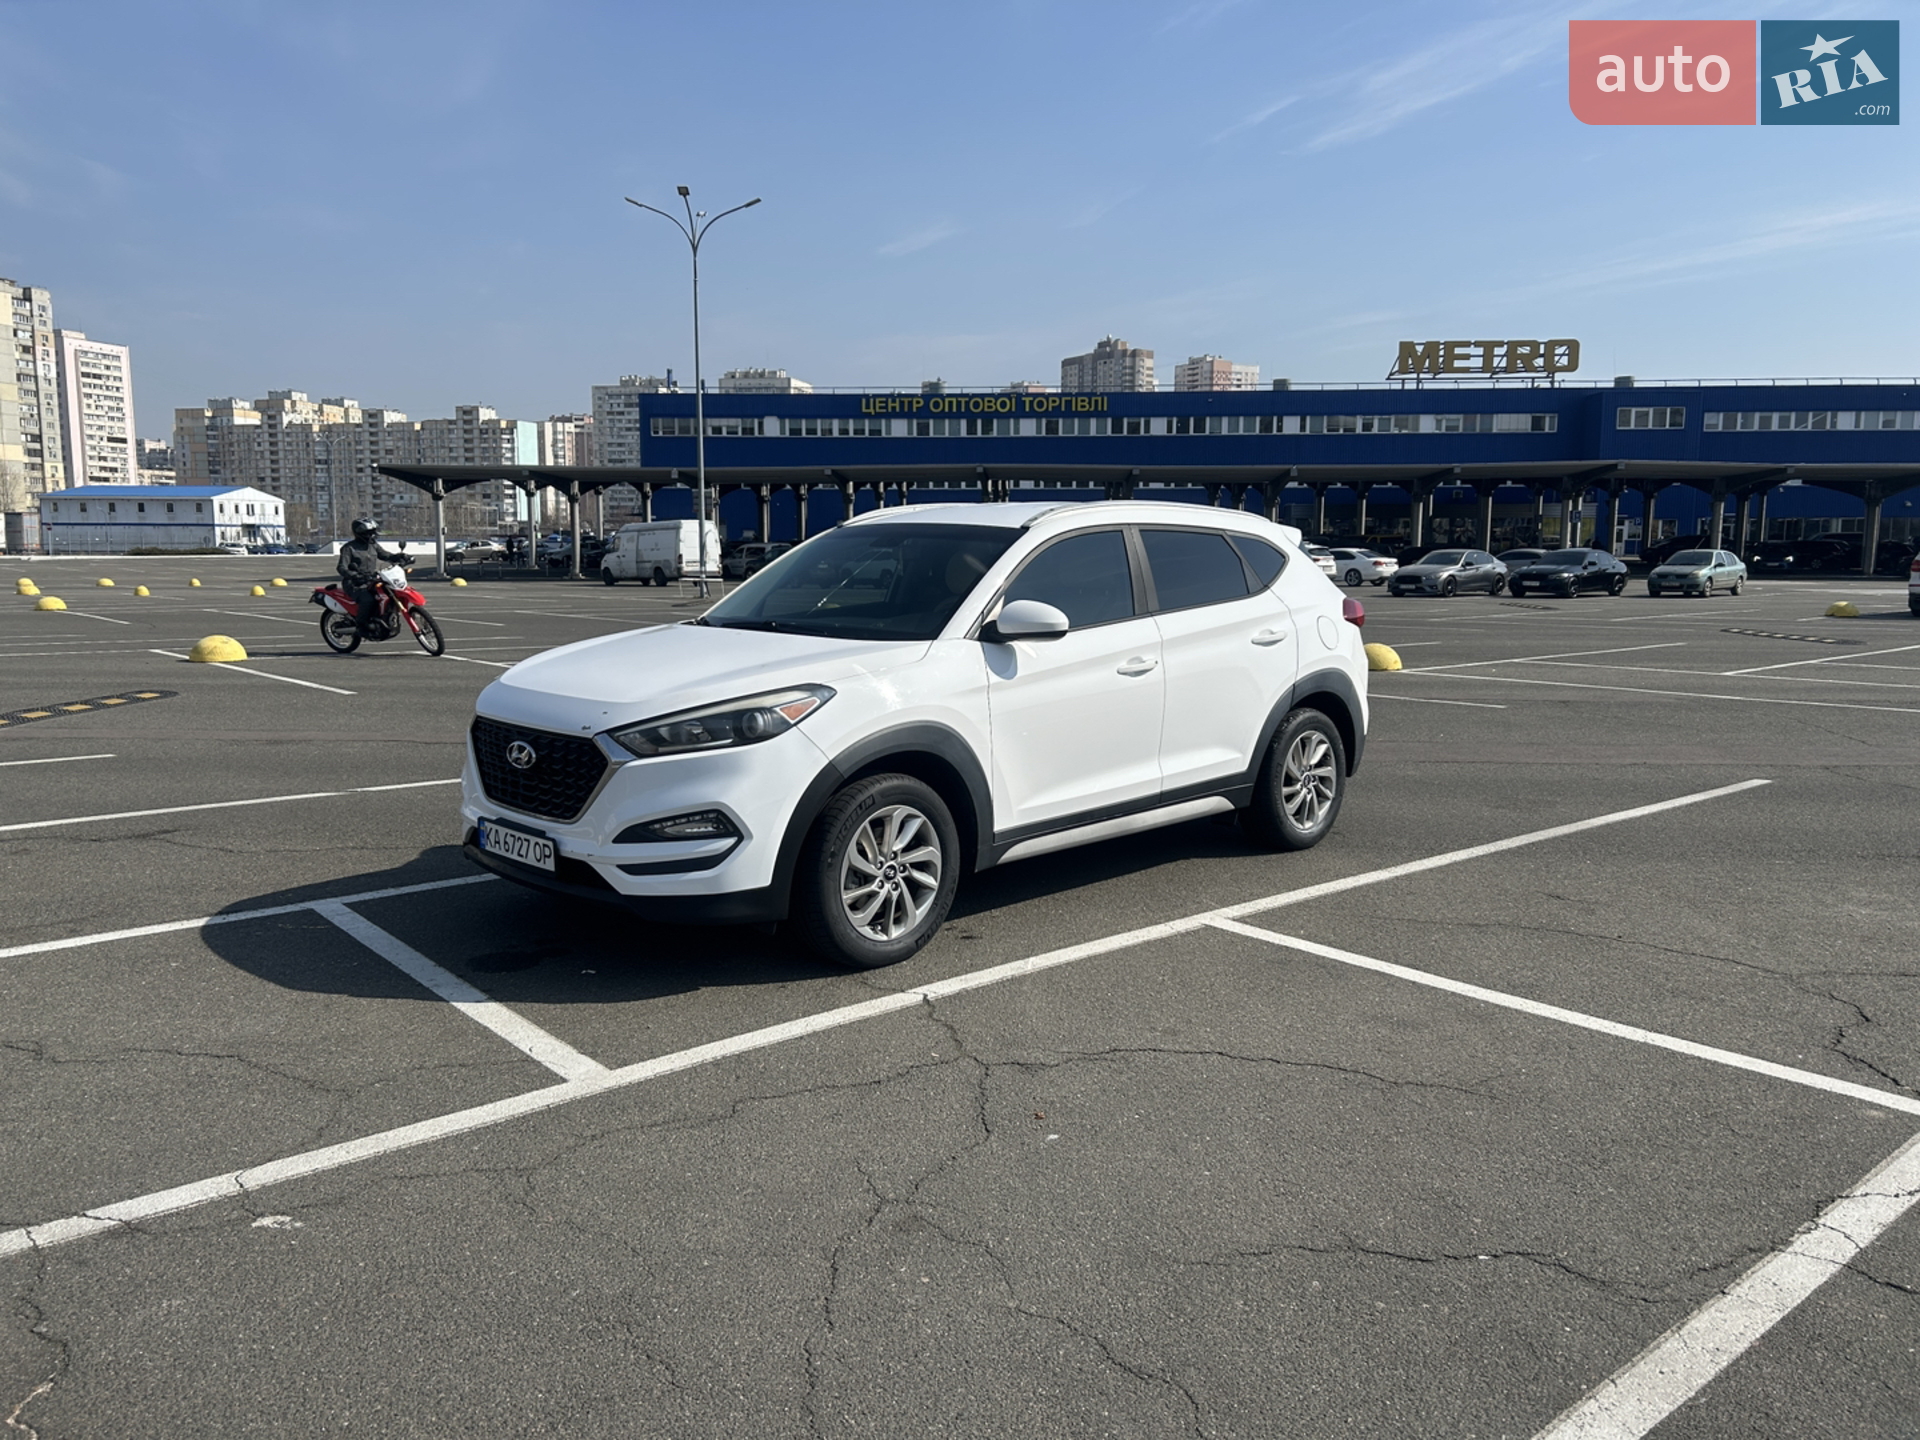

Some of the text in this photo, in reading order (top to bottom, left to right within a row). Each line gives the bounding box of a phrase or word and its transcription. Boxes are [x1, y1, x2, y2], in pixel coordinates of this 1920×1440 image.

[1398, 338, 1580, 374] METRO
[861, 394, 1108, 415] ЦЕНТР ОПТОВОЇ ТОРГІВЛІ
[503, 832, 530, 859] 6727
[533, 841, 552, 865] OP
